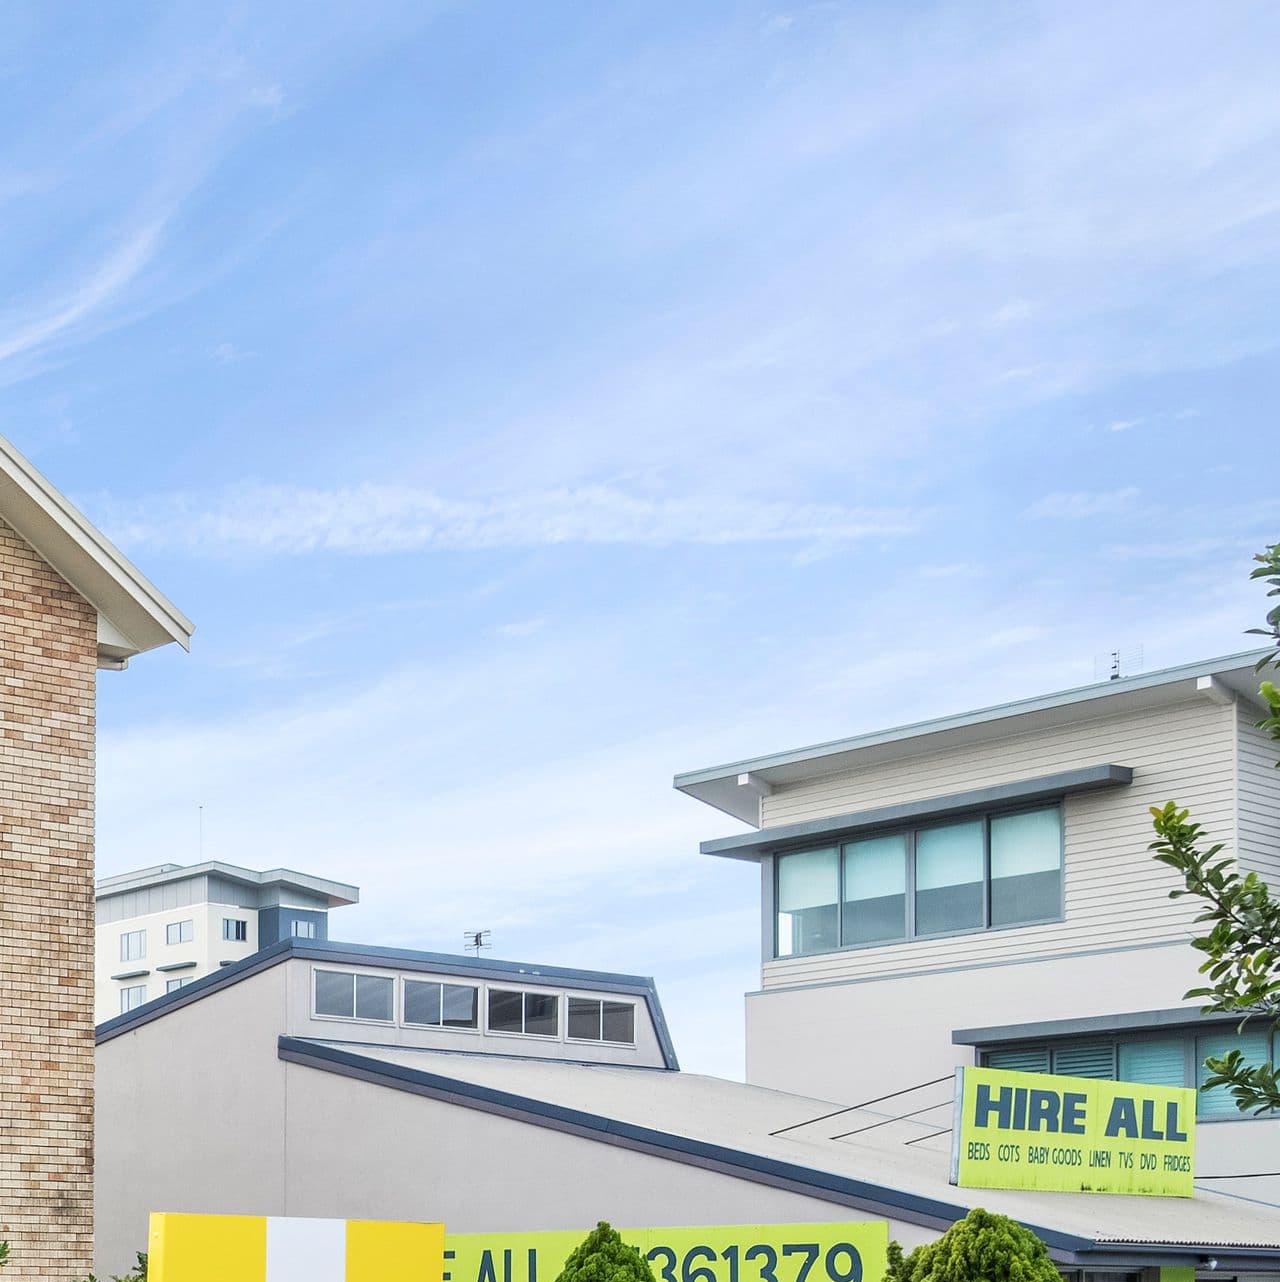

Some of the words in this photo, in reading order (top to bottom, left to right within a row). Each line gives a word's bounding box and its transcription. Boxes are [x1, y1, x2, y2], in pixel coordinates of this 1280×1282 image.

[974, 1084, 1087, 1135] HIRE
[1104, 1097, 1187, 1142] ALL
[968, 1142, 990, 1161] BEDS
[998, 1144, 1020, 1163] COTS
[1028, 1146, 1049, 1165] BABY
[1052, 1148, 1082, 1166] GOODS
[1089, 1150, 1111, 1168] LINEN
[1119, 1152, 1133, 1169] TVS
[1140, 1153, 1157, 1171] DVD
[1163, 1154, 1190, 1173] FRIDGES
